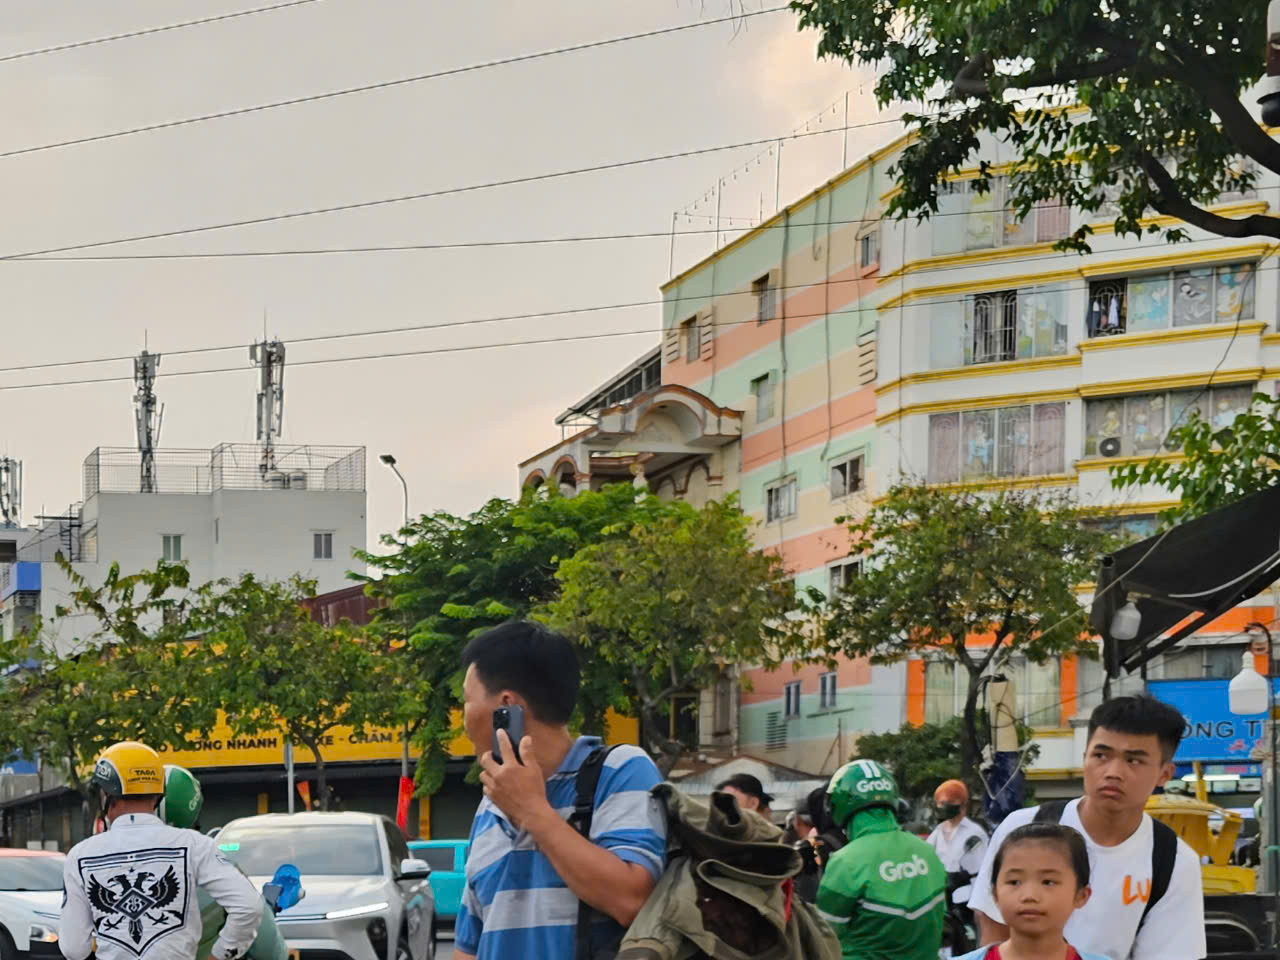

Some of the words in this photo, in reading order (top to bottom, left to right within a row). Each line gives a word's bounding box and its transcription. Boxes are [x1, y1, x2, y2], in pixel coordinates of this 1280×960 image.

[227, 738, 277, 750] NHANH
[856, 779, 892, 793] Grab
[878, 854, 929, 882] Grab
